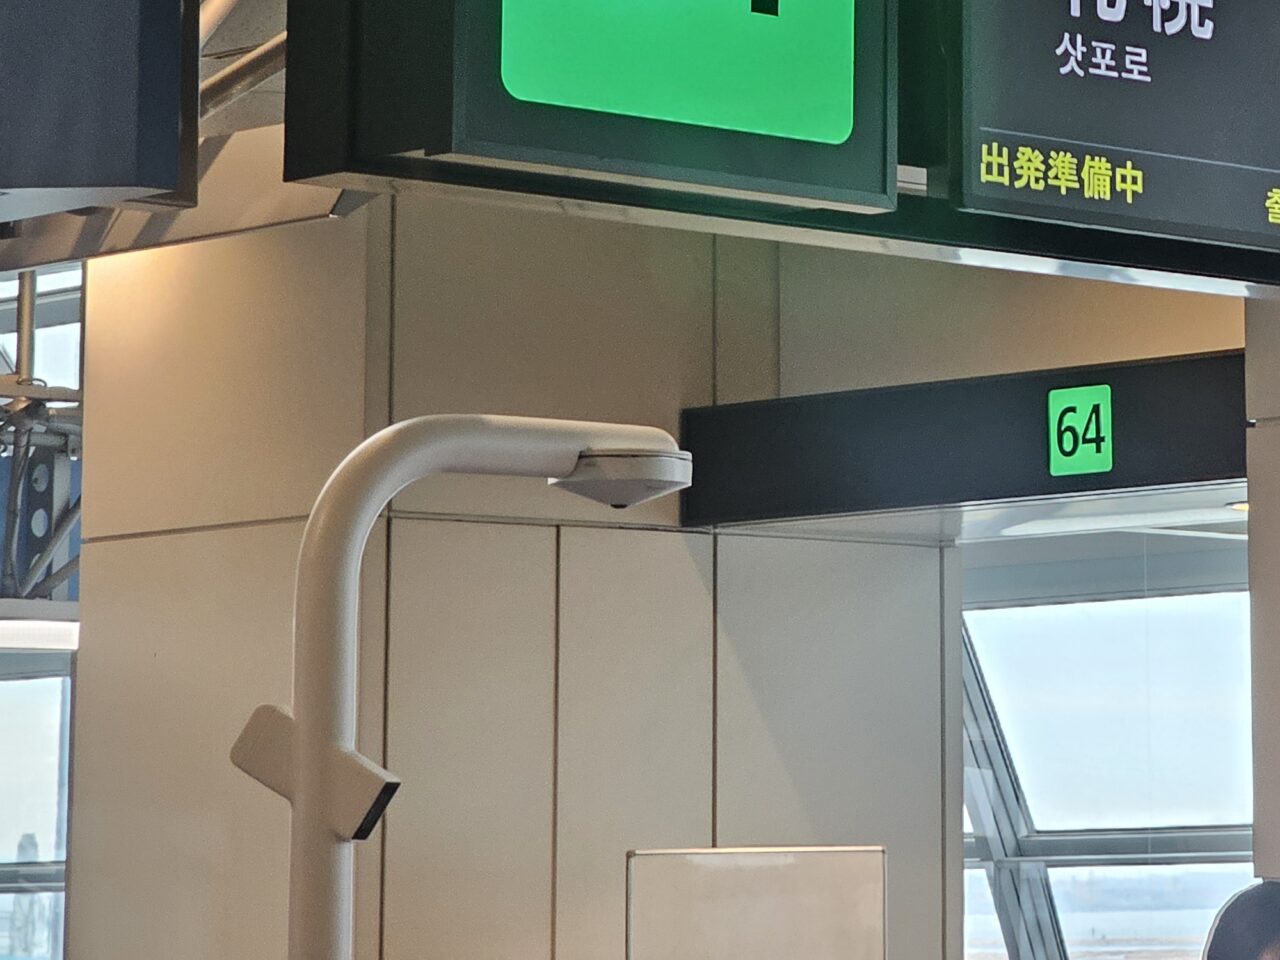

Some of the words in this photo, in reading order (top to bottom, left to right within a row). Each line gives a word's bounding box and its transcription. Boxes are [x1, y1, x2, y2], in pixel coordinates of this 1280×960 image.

[1055, 32, 1152, 83] 삿포로
[980, 142, 1145, 205] 出発準備中
[1056, 403, 1106, 458] 64
